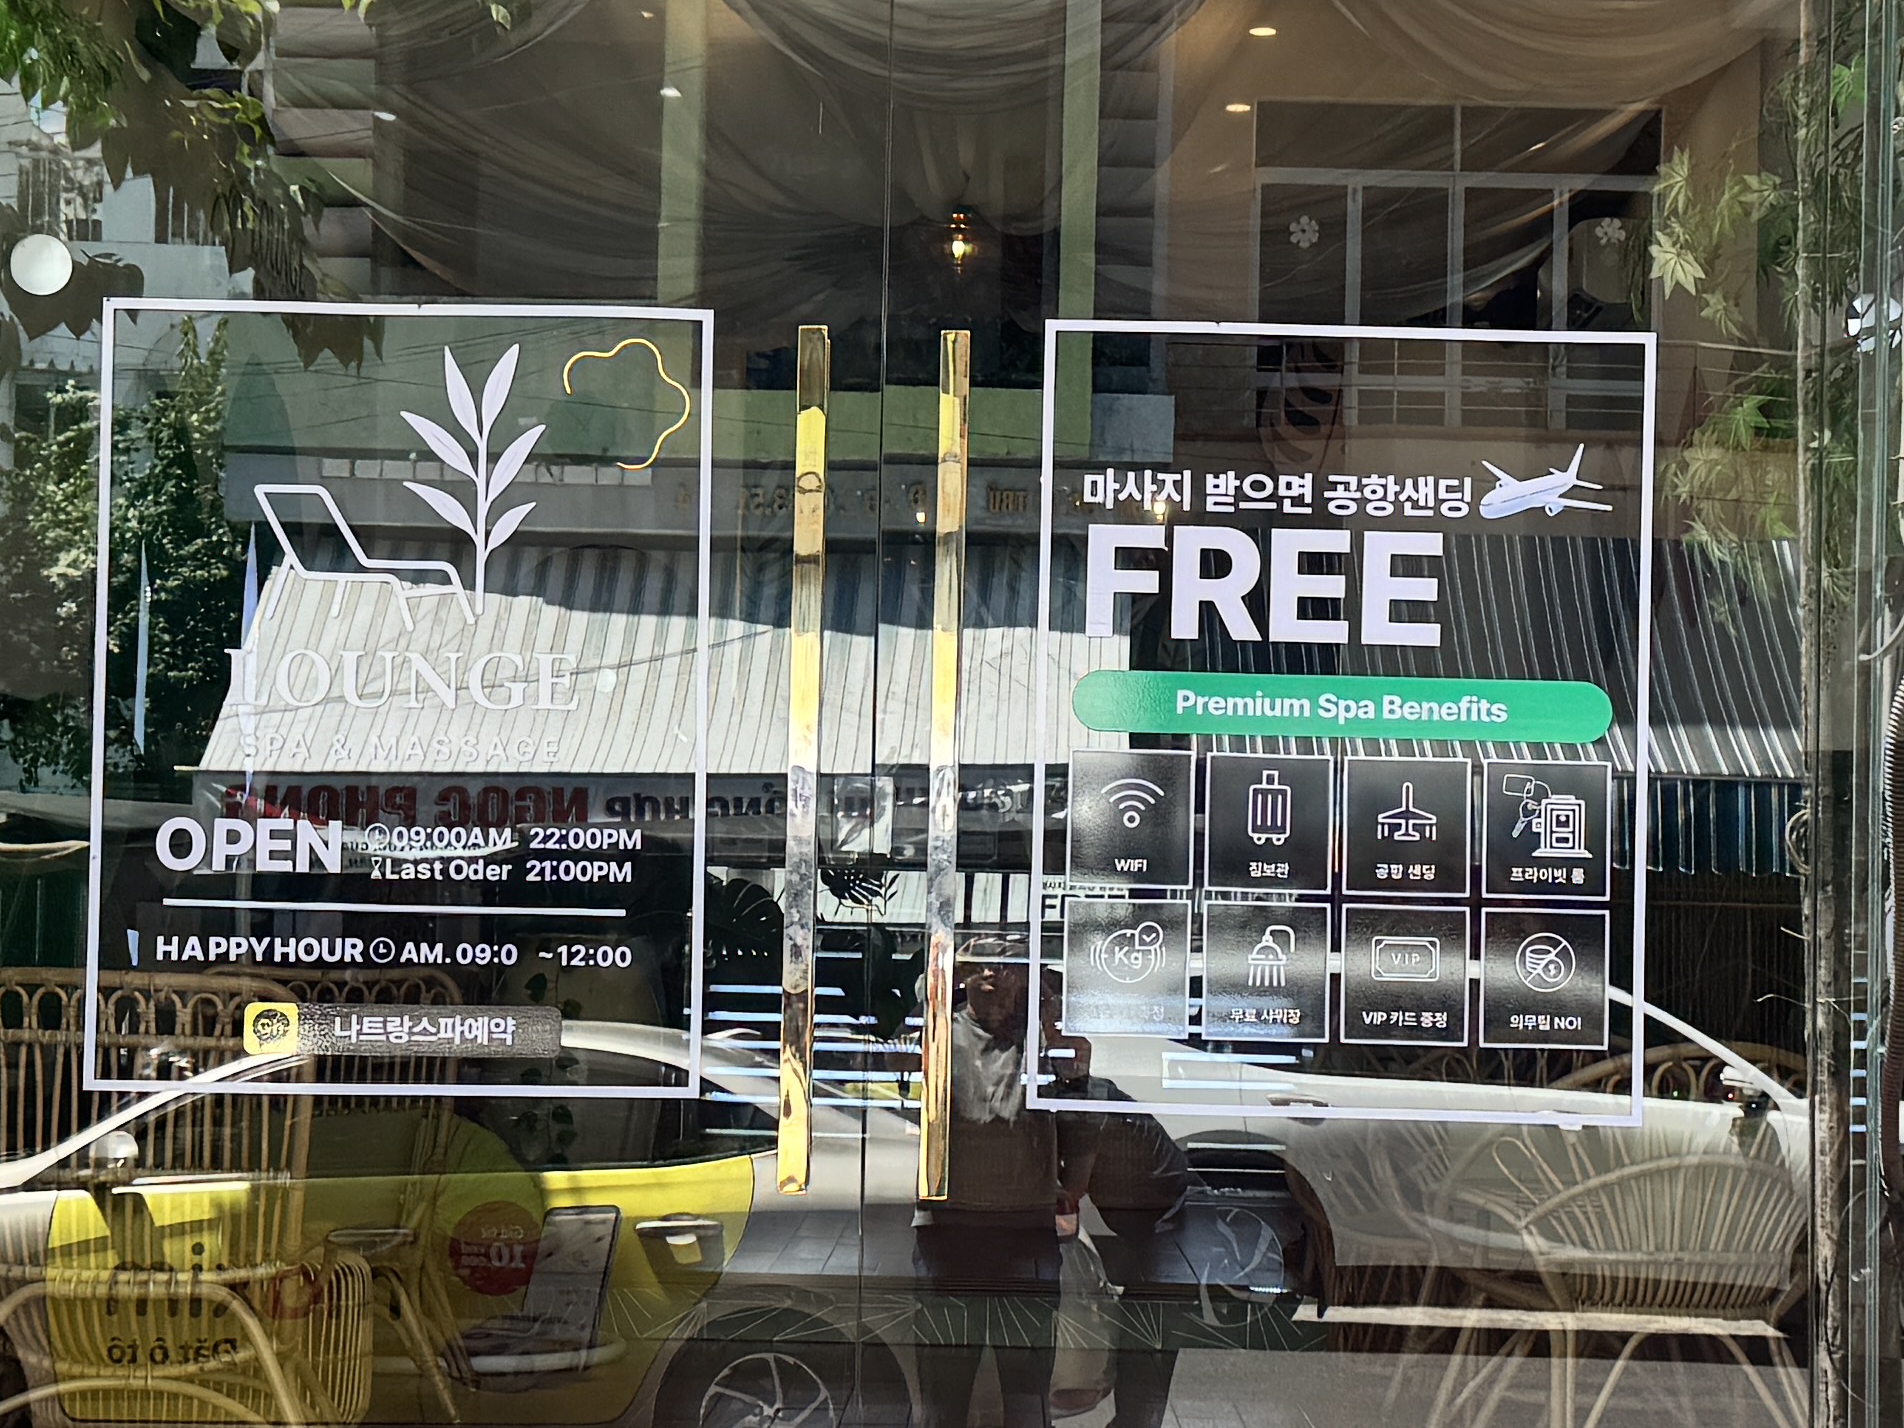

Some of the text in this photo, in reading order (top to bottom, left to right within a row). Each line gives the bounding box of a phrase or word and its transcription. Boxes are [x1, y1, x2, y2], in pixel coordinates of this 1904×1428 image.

[1082, 467, 1191, 512] 마사지
[1205, 470, 1313, 514] 받으면
[1323, 473, 1472, 518] 공항샌딩
[1085, 523, 1444, 648] FREE
[224, 648, 580, 712] LOUNGE
[1175, 689, 1509, 724] Premium Spa Benefits
[239, 732, 562, 764] SPA & MASSAGE
[155, 816, 343, 874] OPEN
[392, 826, 512, 850] 09:00AM
[529, 827, 642, 851] 22:00PM
[385, 859, 632, 883] Last Oder 21:00PM
[1114, 858, 1148, 872] WIFI
[1510, 866, 1567, 884] 프라이빗
[1114, 946, 1144, 970] Kg
[1391, 952, 1422, 965] VIP
[334, 1014, 516, 1046] 나트랑스파예약
[1362, 1011, 1388, 1025] VIP
[1390, 1010, 1418, 1027] 카드
